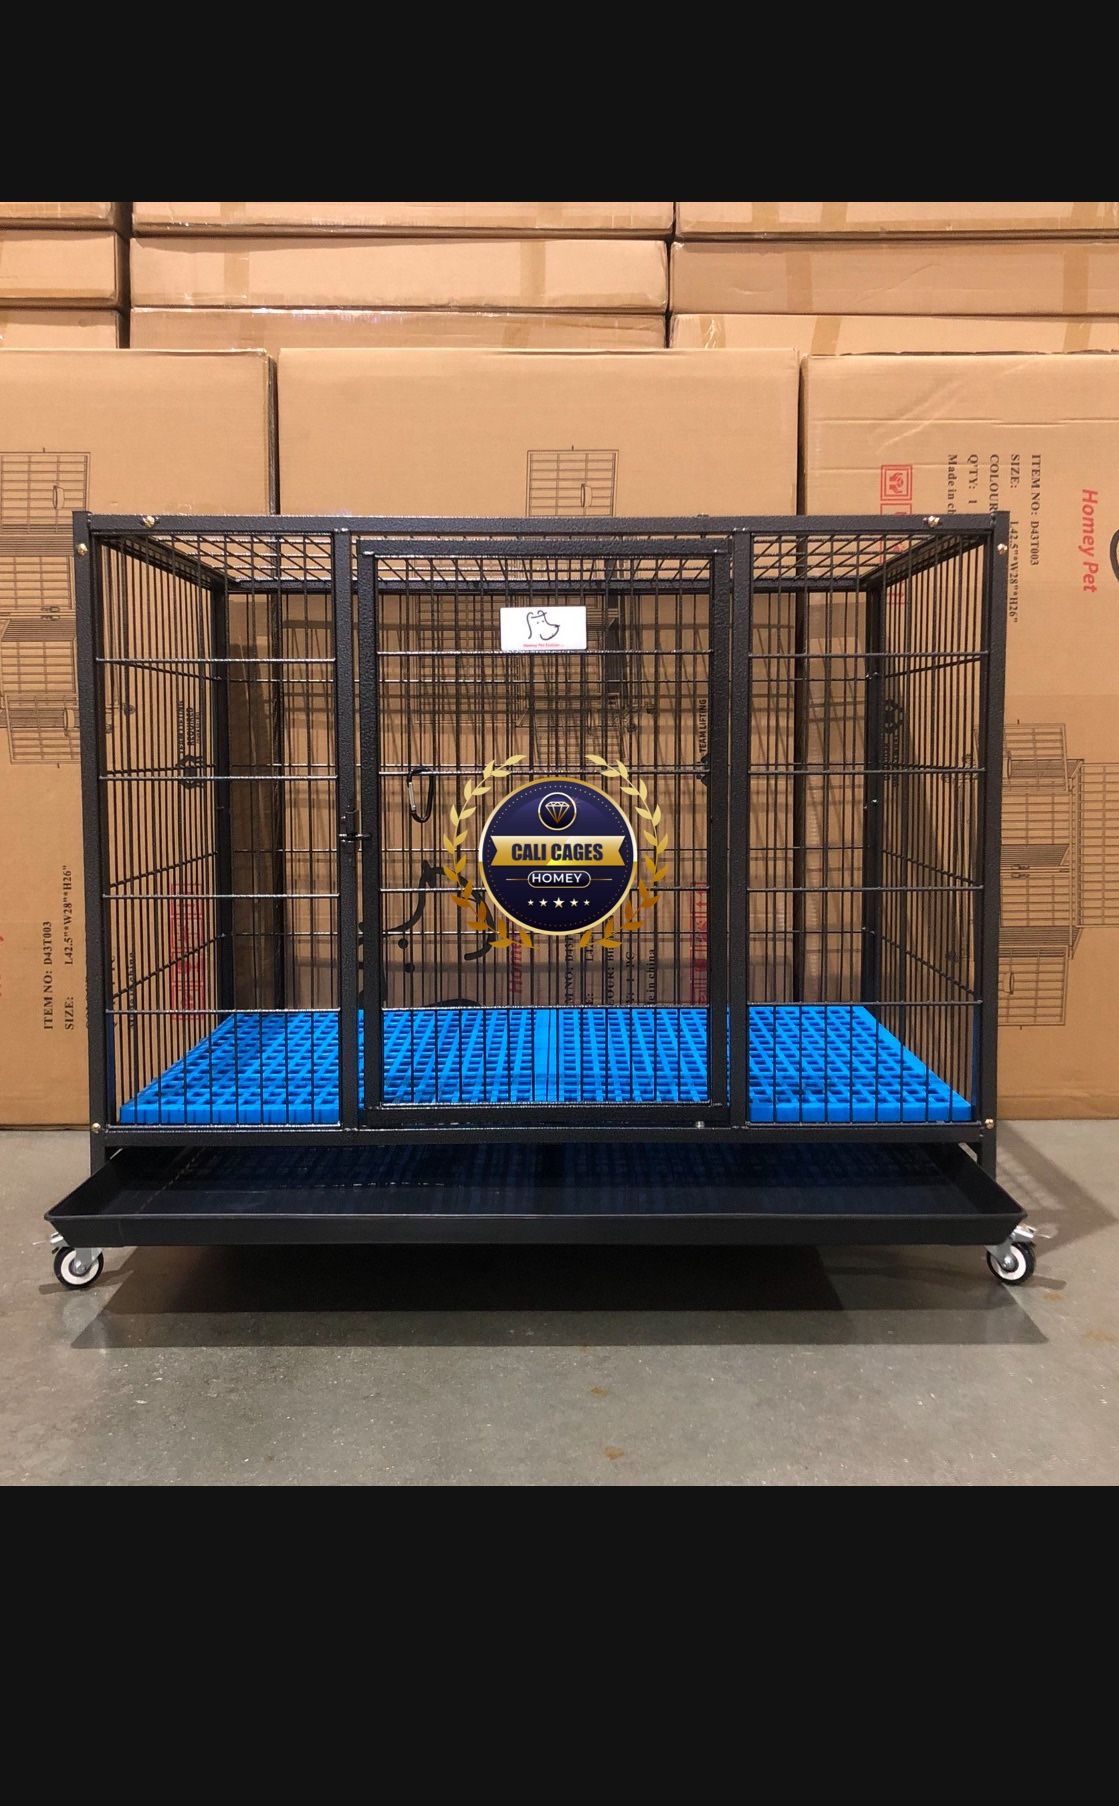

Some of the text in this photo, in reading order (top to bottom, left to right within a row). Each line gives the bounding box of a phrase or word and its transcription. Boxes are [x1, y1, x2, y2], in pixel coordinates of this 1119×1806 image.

[947, 454, 957, 487] Made
[1010, 454, 1020, 489] SIZE:
[947, 489, 957, 500] in
[1030, 454, 1041, 566] ITEM NO: D43T003
[1078, 489, 1099, 593] Homey Pet
[699, 699, 707, 753] TEAM LIFTING
[42, 921, 53, 1030] ITEM NO: D43T003
[64, 996, 74, 1030] SIZE:
